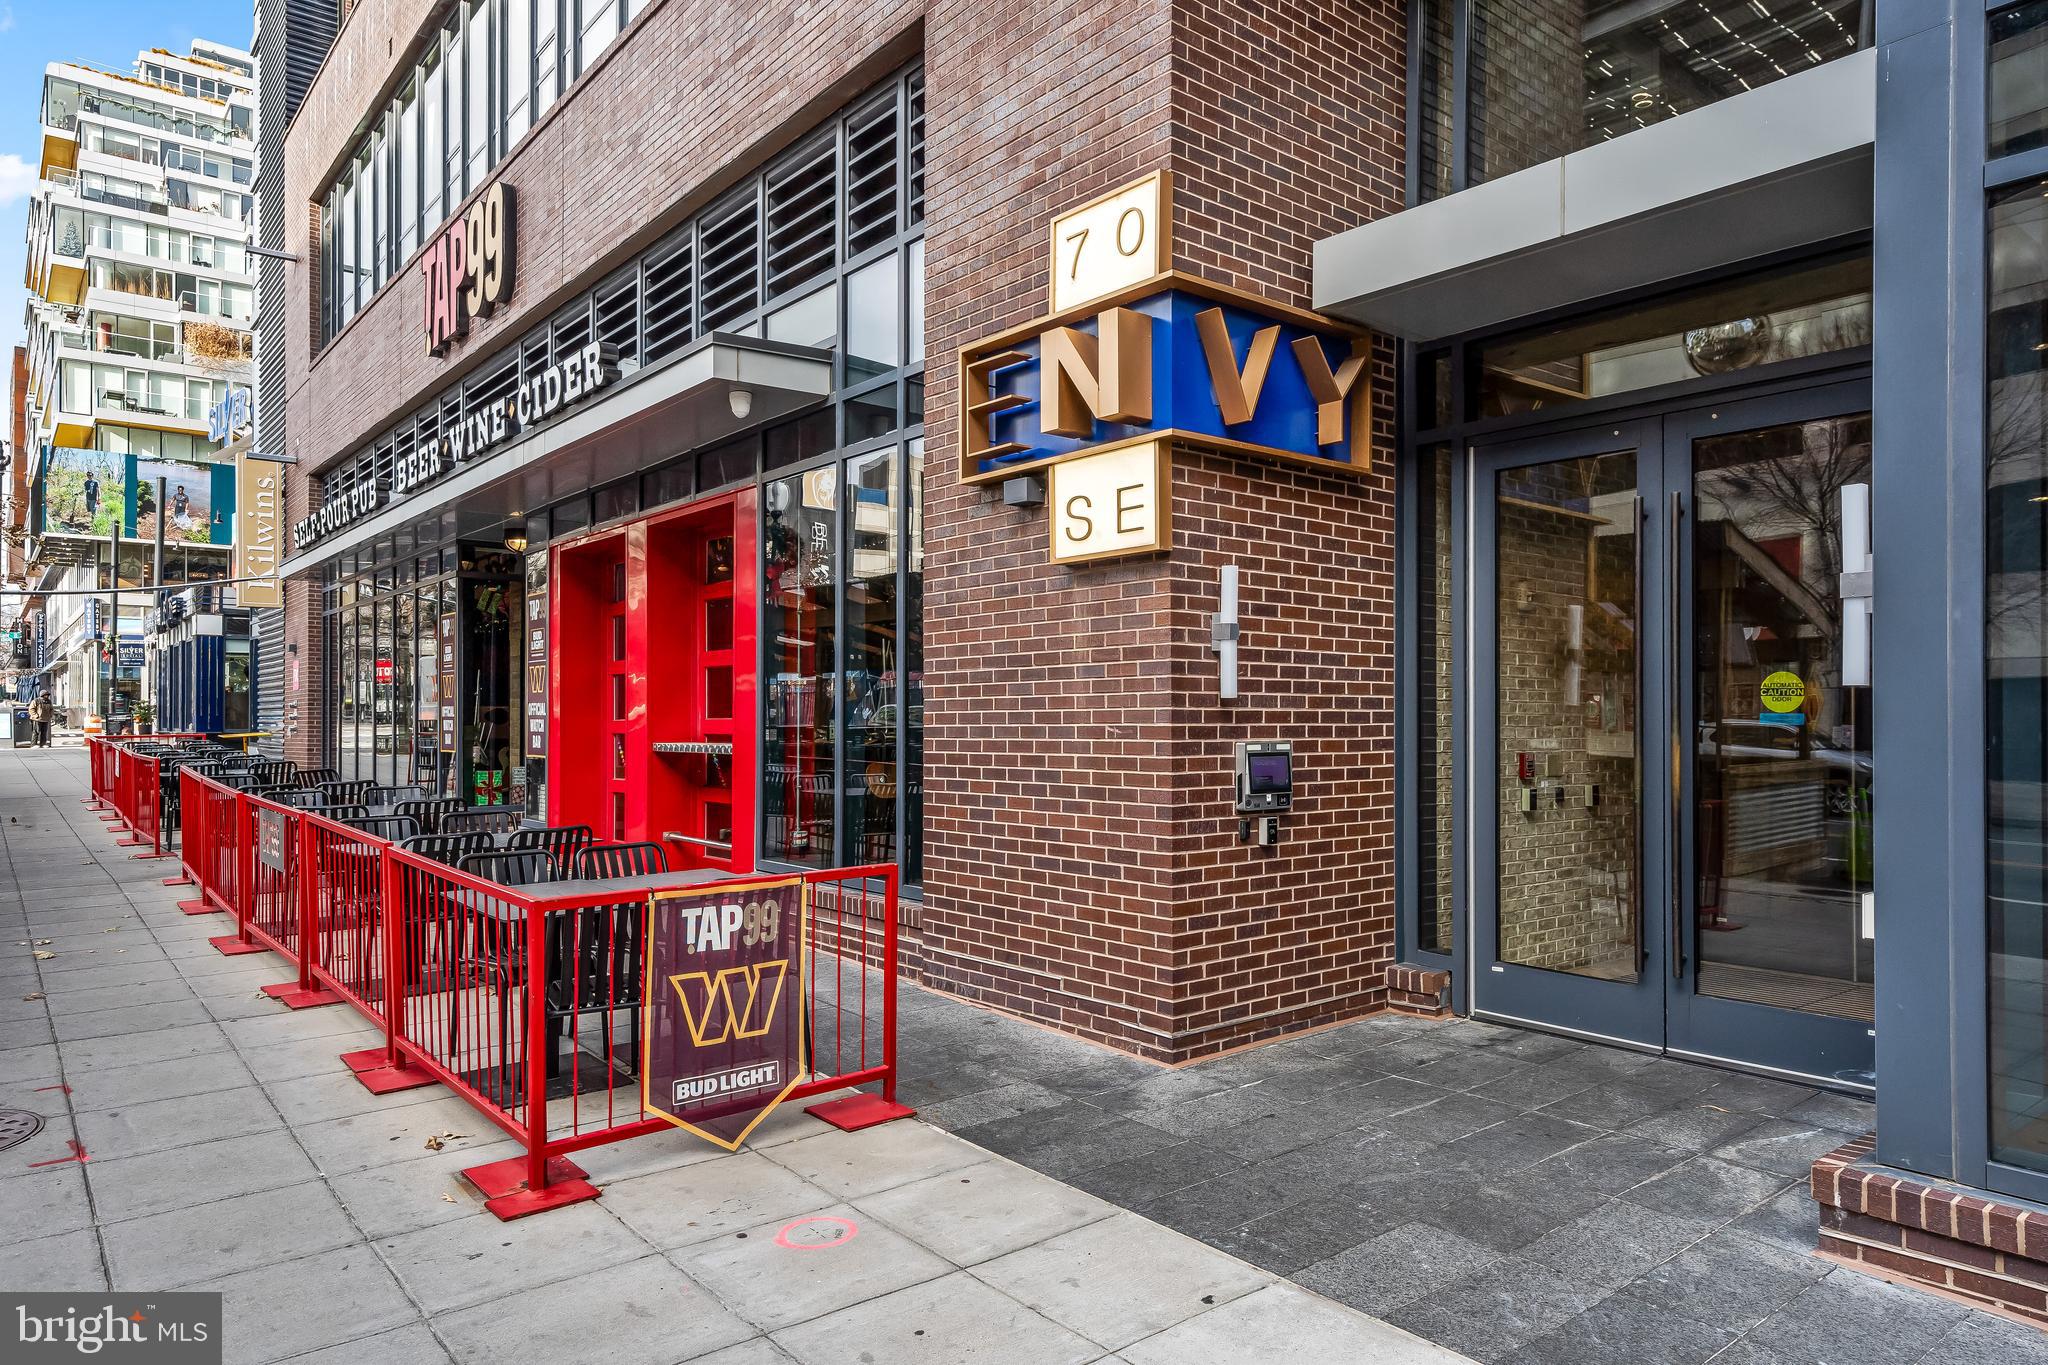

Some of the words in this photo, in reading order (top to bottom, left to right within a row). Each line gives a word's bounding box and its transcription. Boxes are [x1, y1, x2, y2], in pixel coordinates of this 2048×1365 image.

[421, 181, 506, 355] TAP99
[1065, 206, 1145, 281] 70
[966, 306, 1366, 458] ENVY
[293, 496, 349, 549] SELF-POUR
[351, 476, 379, 516] PUB
[396, 438, 442, 493] BEER
[448, 396, 508, 462] WINE
[517, 340, 606, 426] CIDER
[246, 477, 276, 590] Kilwins
[1065, 483, 1145, 542] SE
[120, 646, 144, 654] SILVER
[529, 665, 545, 694] W
[1761, 688, 1804, 696] CAUTION
[682, 899, 779, 954] TAP99
[669, 959, 789, 1048] W
[676, 1079, 718, 1101] BUD
[720, 1065, 775, 1092] LIGHT
